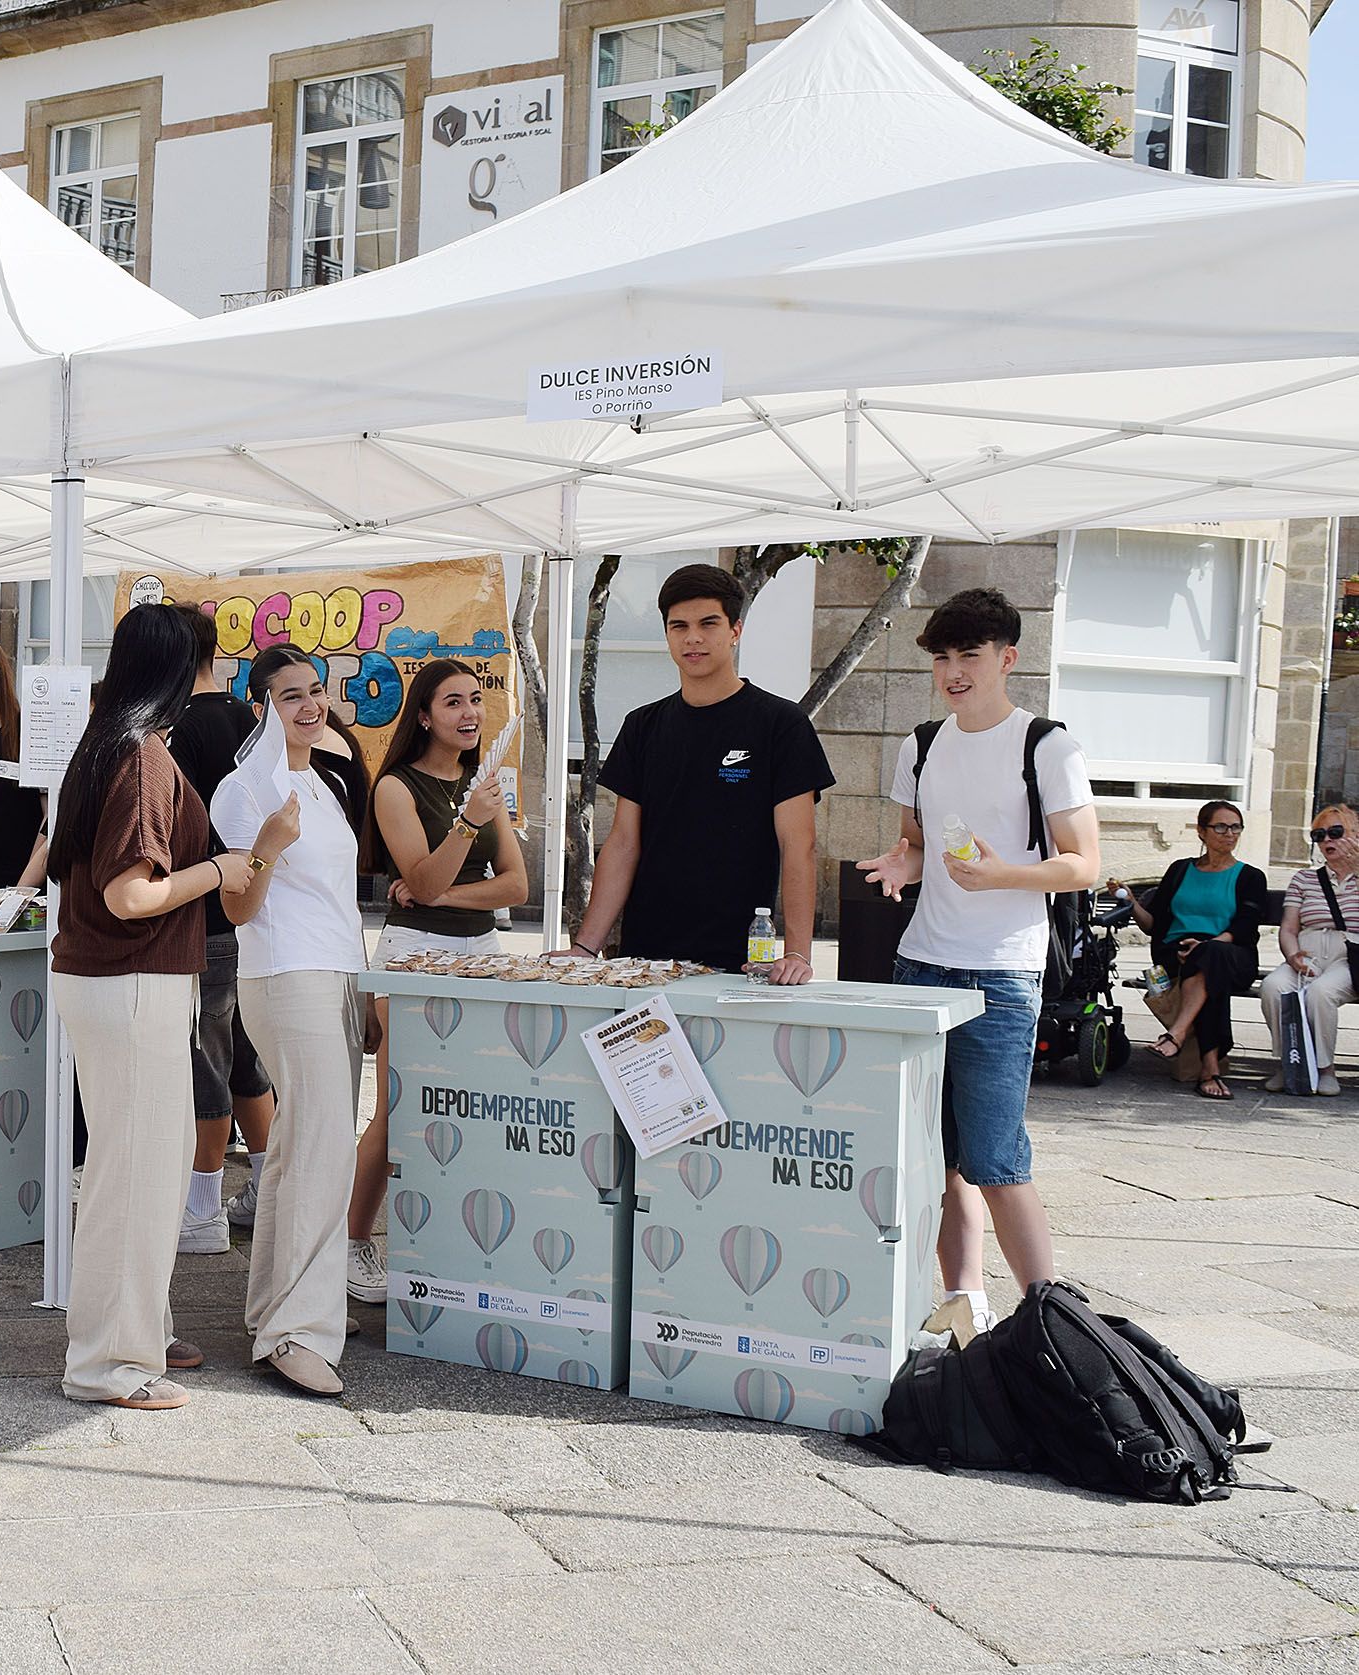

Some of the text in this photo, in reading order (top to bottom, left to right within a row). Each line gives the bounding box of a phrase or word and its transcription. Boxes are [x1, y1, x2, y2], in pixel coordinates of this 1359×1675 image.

[460, 128, 552, 146] GESTORIA AESORIA FSCAL
[541, 354, 711, 389] DULCE INVERSIÓN
[574, 383, 673, 401] IES Pino Manso
[592, 400, 652, 414] O Porriño
[476, 662, 490, 673] DE
[597, 1008, 652, 1040] CATÁLOGO DE
[602, 1019, 653, 1050] PRODUCTOS
[422, 1086, 576, 1129] DEPOEMPRENDE
[506, 1126, 575, 1157] NA ESO
[772, 1157, 853, 1191] NA ESO
[430, 1286, 465, 1297] Deputación
[430, 1292, 465, 1303] Pontevedra
[491, 1296, 514, 1305] XUNTA
[491, 1302, 529, 1315] DE GALICIA
[543, 1305, 554, 1315] FP
[681, 1335, 722, 1347] Pontevedra
[682, 1328, 722, 1341] Deputación
[752, 1340, 779, 1349] XUNTA
[752, 1346, 796, 1360] DE GALICIA
[813, 1351, 826, 1360] FP
